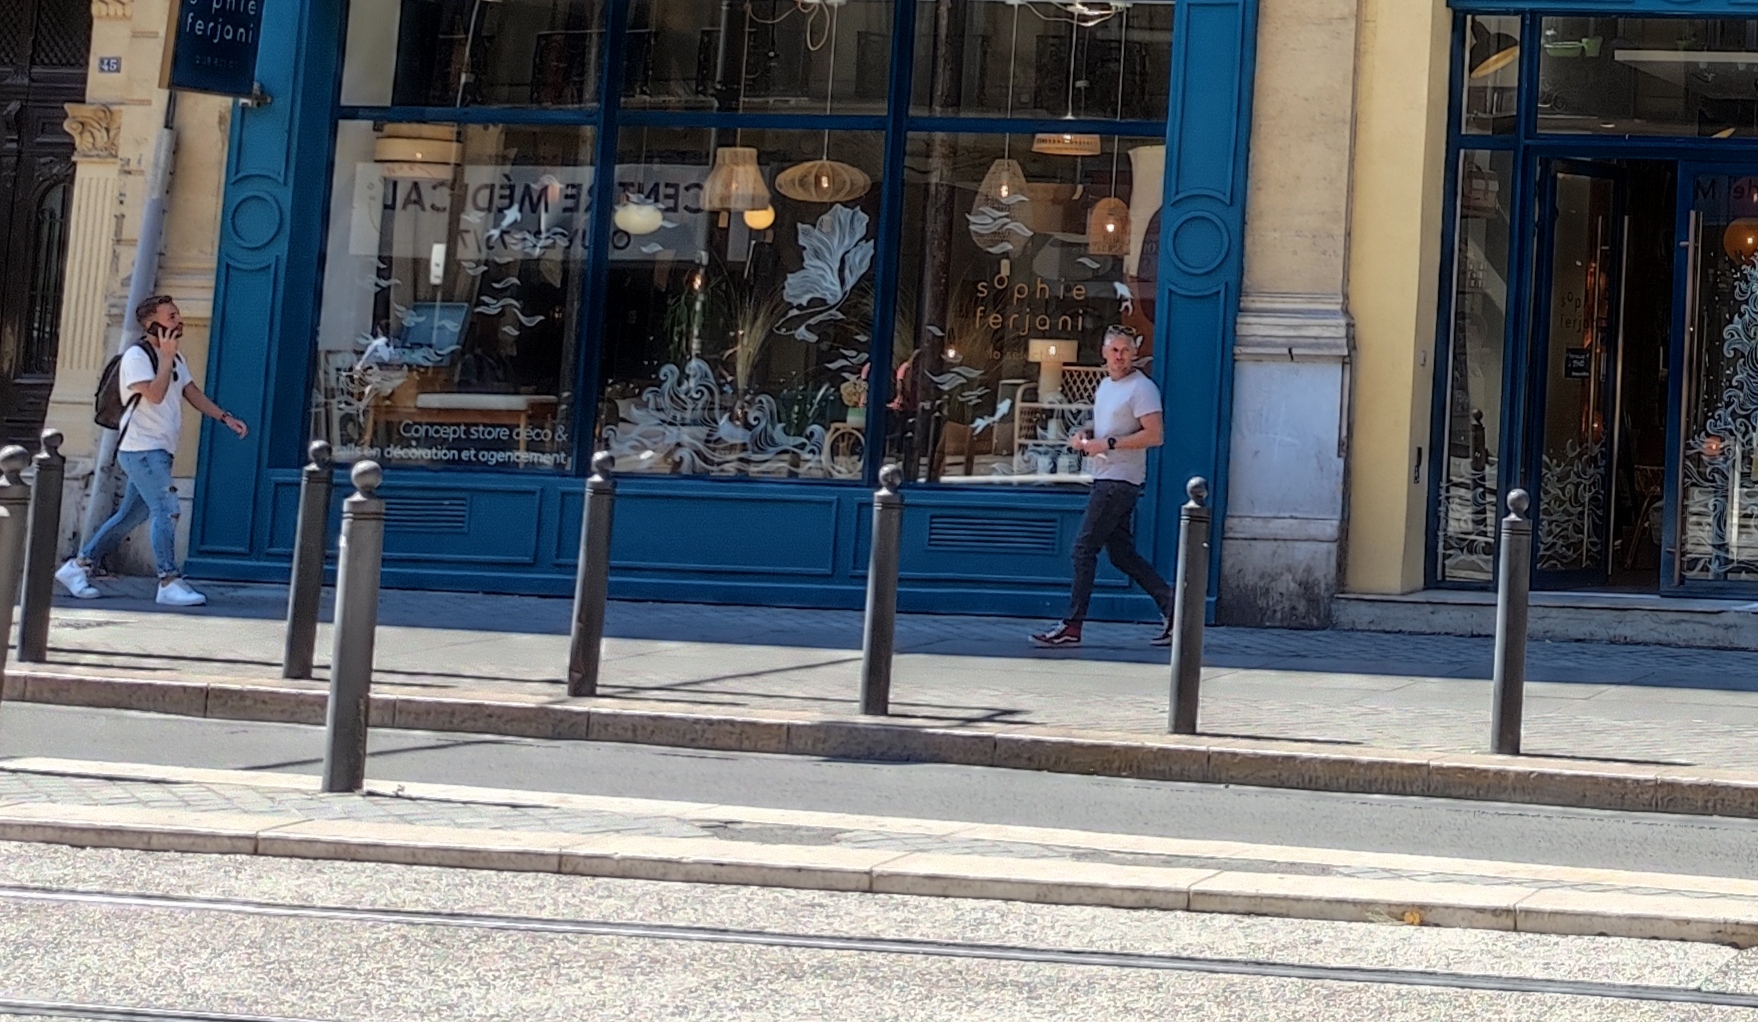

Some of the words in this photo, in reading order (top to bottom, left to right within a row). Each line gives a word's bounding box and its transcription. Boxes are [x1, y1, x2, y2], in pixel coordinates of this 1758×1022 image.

[186, 12, 254, 44] ferjani
[976, 273, 1086, 305] sophie
[975, 306, 1084, 335] ferjani
[400, 419, 466, 441] Concept
[469, 423, 510, 441] store
[512, 423, 551, 442] déco
[555, 425, 568, 442] &
[383, 443, 459, 460] décoration
[461, 448, 476, 461] et
[478, 450, 567, 467] agencement
